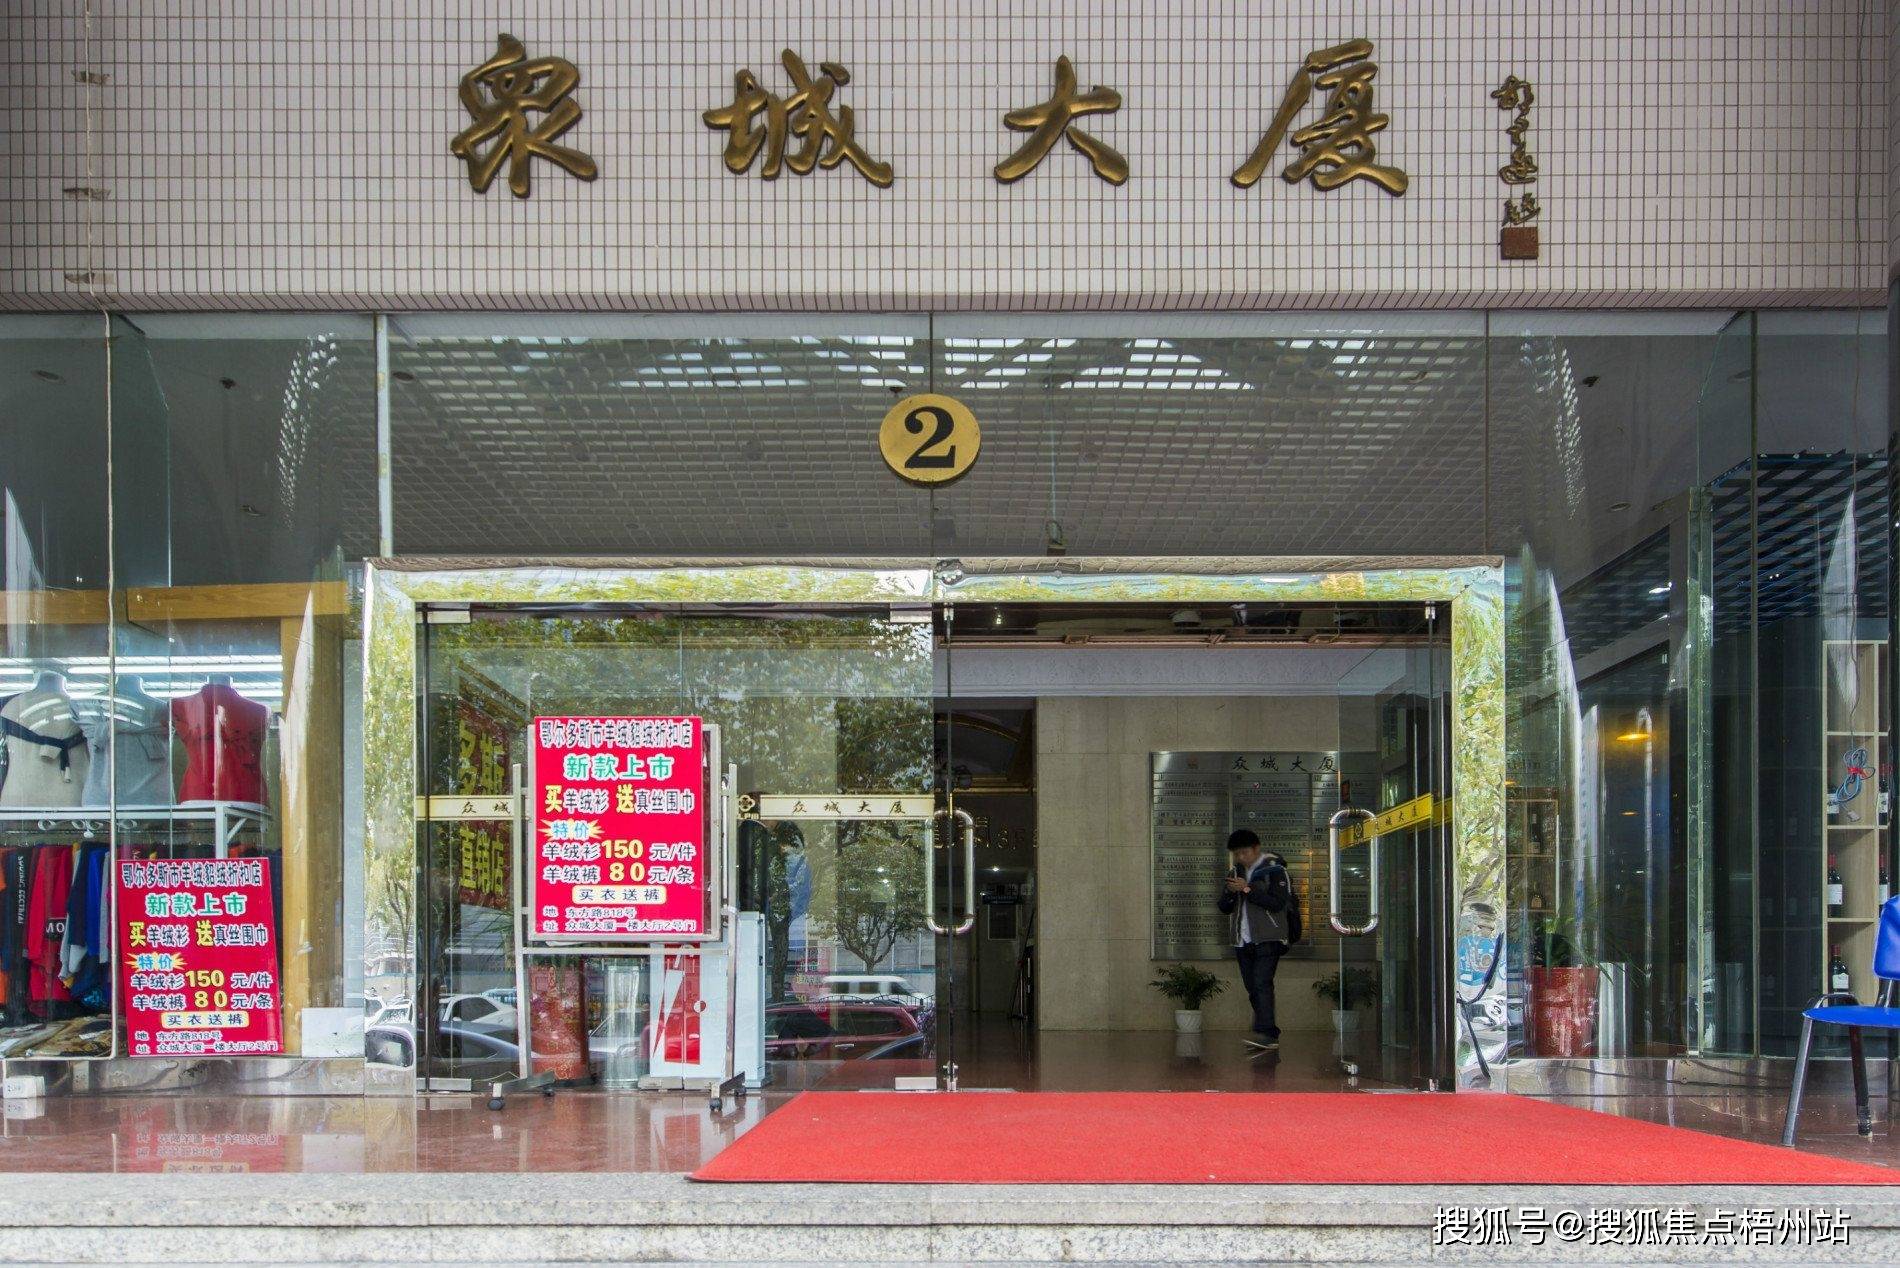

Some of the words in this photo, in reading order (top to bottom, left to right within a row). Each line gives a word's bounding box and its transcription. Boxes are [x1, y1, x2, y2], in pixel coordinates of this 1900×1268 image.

[904, 406, 956, 468] 2
[563, 753, 674, 780] 新款上市
[1232, 755, 1337, 773] 众城大厦
[545, 785, 609, 813] 买羊绒衫
[616, 784, 694, 813] 送真丝围巾
[792, 800, 906, 815] 众城大厦
[552, 822, 590, 840] 特价
[578, 888, 660, 901] 买衣送裤
[145, 892, 247, 916] 新款上市
[129, 921, 190, 947] 买羊绒衫
[196, 919, 268, 947] 送真丝围巾
[137, 955, 174, 970] 特价
[167, 1014, 244, 1026] 买衣送裤
